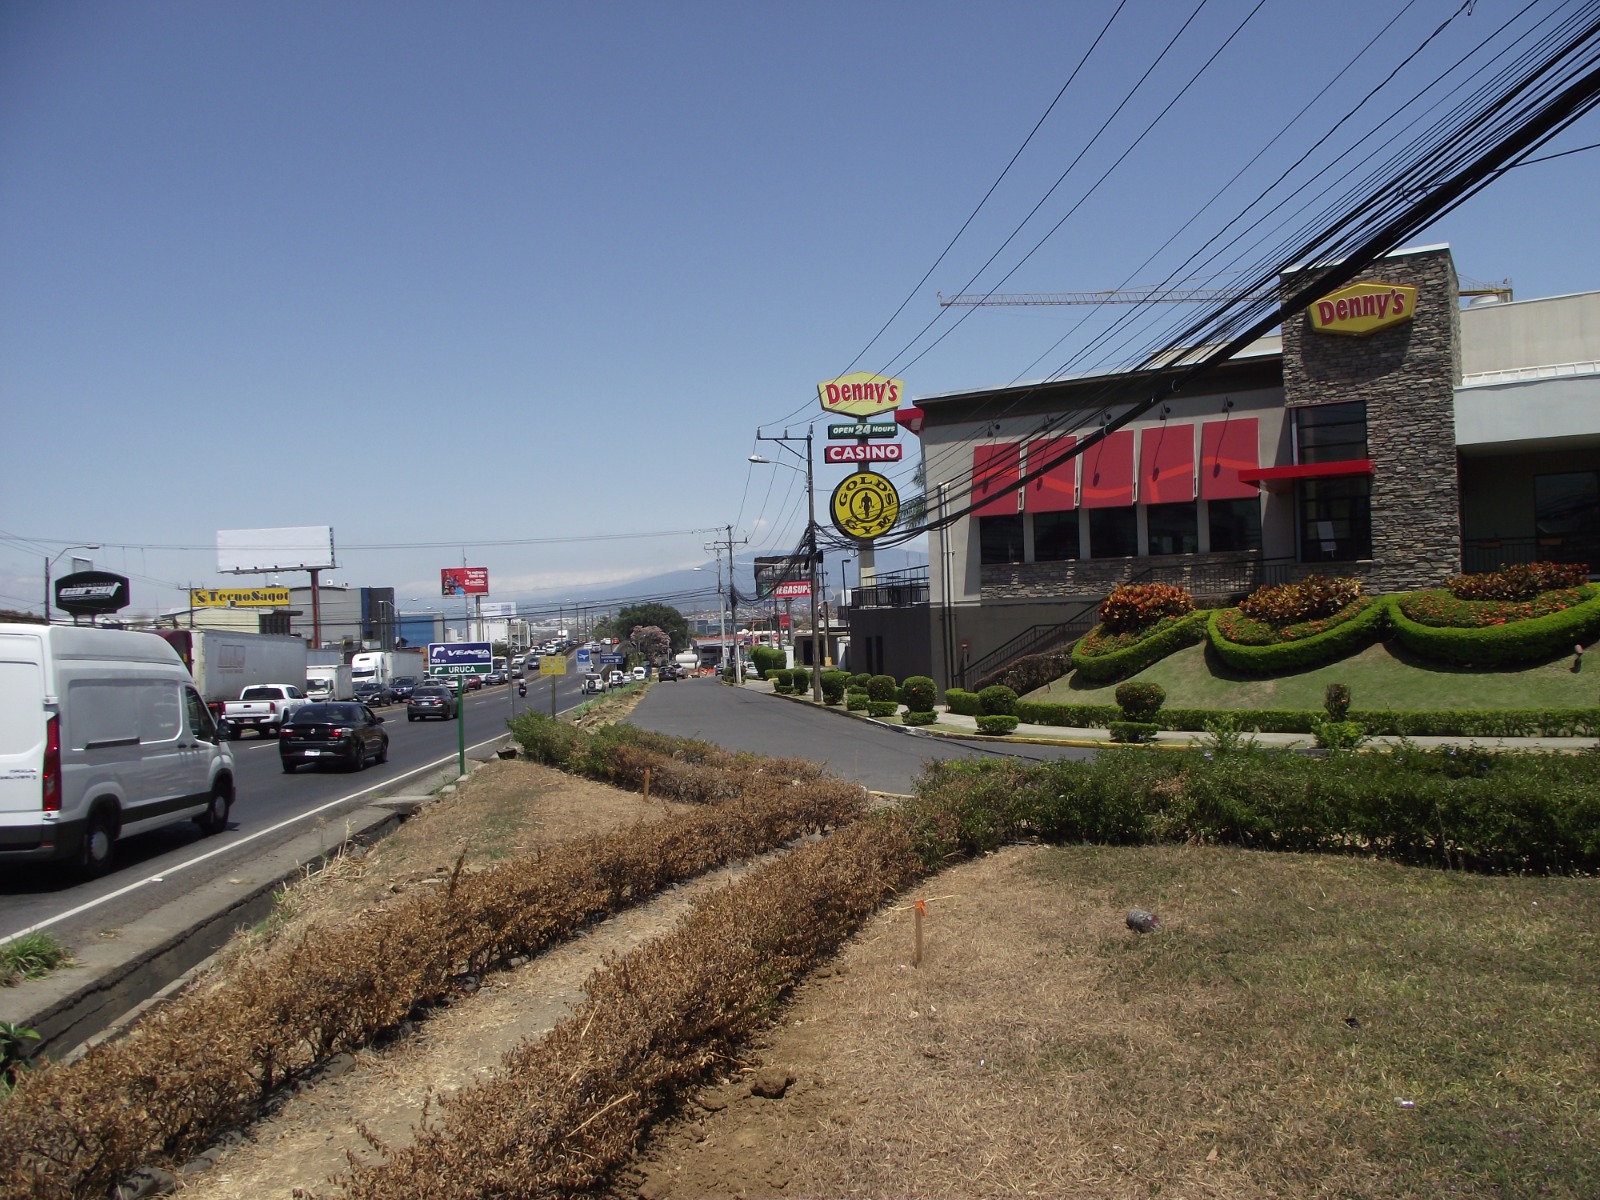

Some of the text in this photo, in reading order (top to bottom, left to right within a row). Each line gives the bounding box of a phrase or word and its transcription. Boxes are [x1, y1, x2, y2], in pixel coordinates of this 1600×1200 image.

[1317, 288, 1405, 326] Denny's
[825, 380, 898, 405] Denny's
[855, 424, 871, 434] 24
[830, 445, 899, 460] CASINO
[839, 476, 894, 507] GOLD'S
[845, 514, 892, 535] GYM
